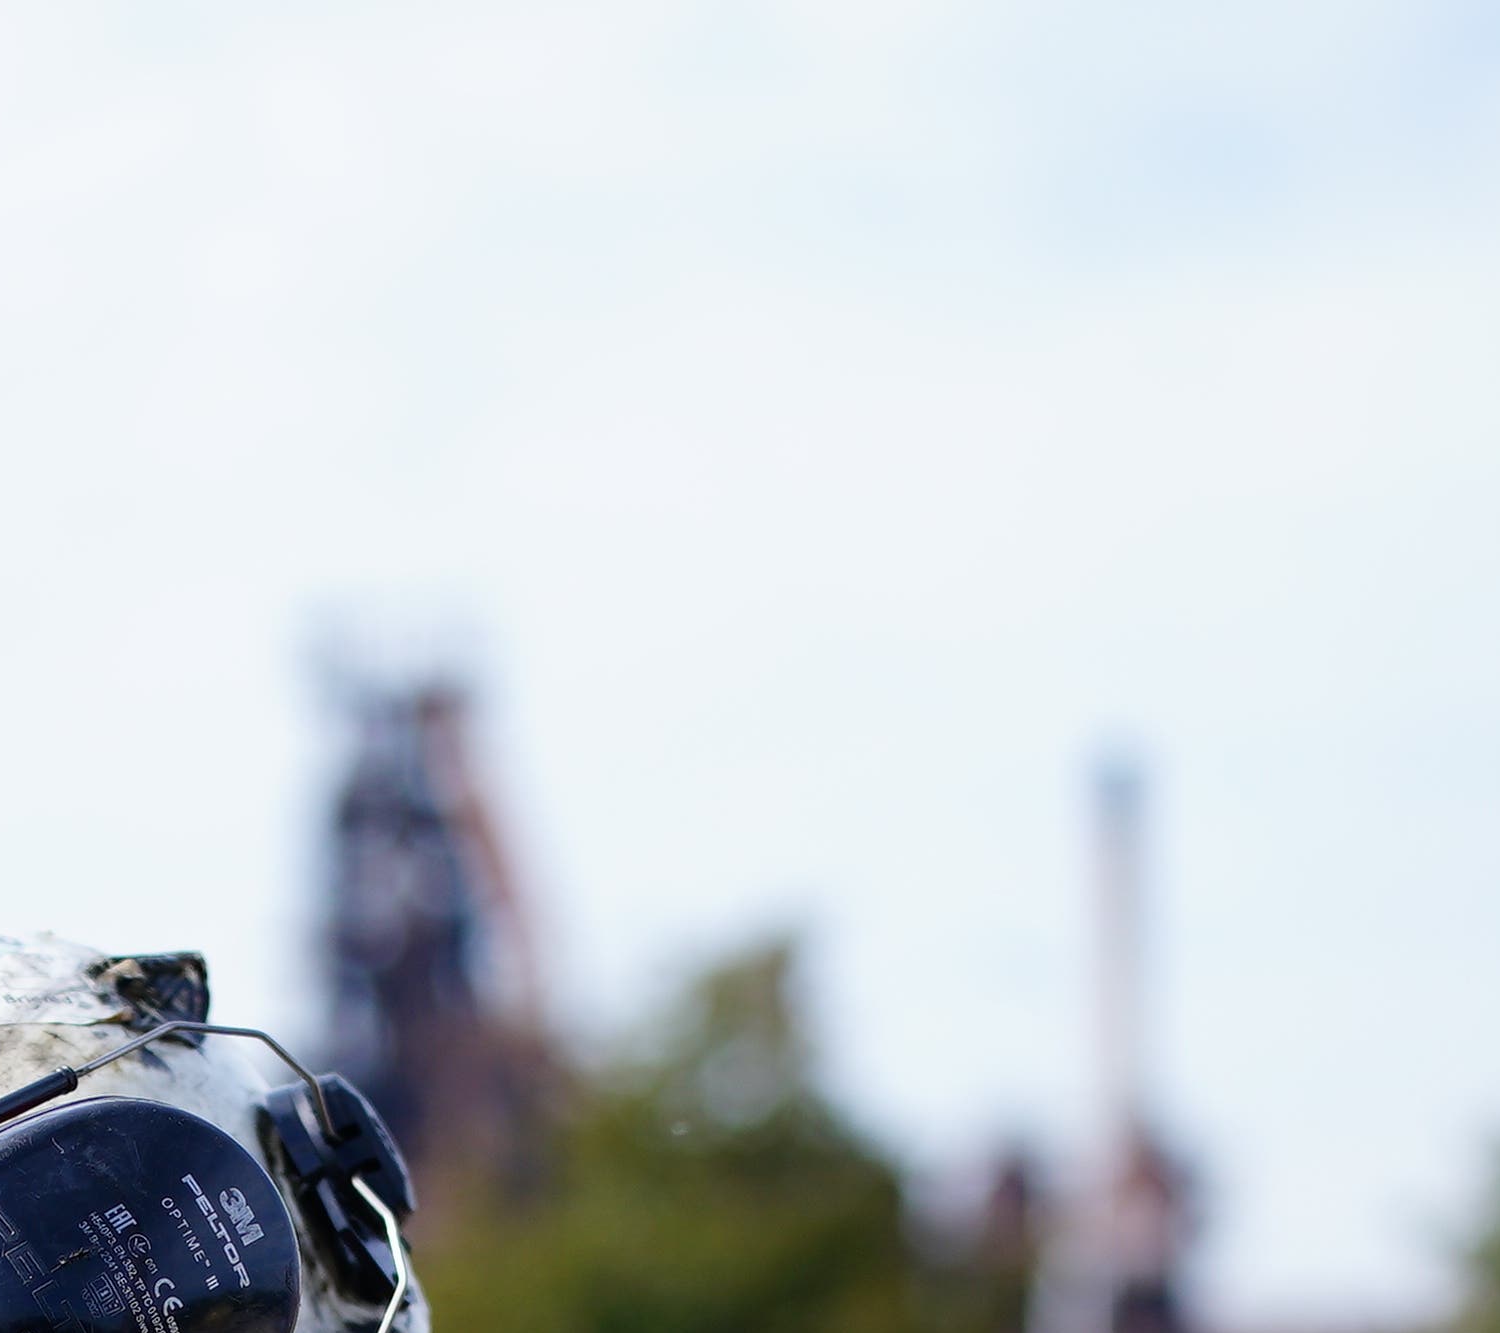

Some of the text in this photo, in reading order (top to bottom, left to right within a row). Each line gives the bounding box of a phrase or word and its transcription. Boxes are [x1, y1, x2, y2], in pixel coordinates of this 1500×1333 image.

[181, 1173, 251, 1289] PELTOR
[219, 1187, 265, 1247] 3M
[133, 1276, 146, 1290] TP
[141, 1290, 154, 1307] TC
